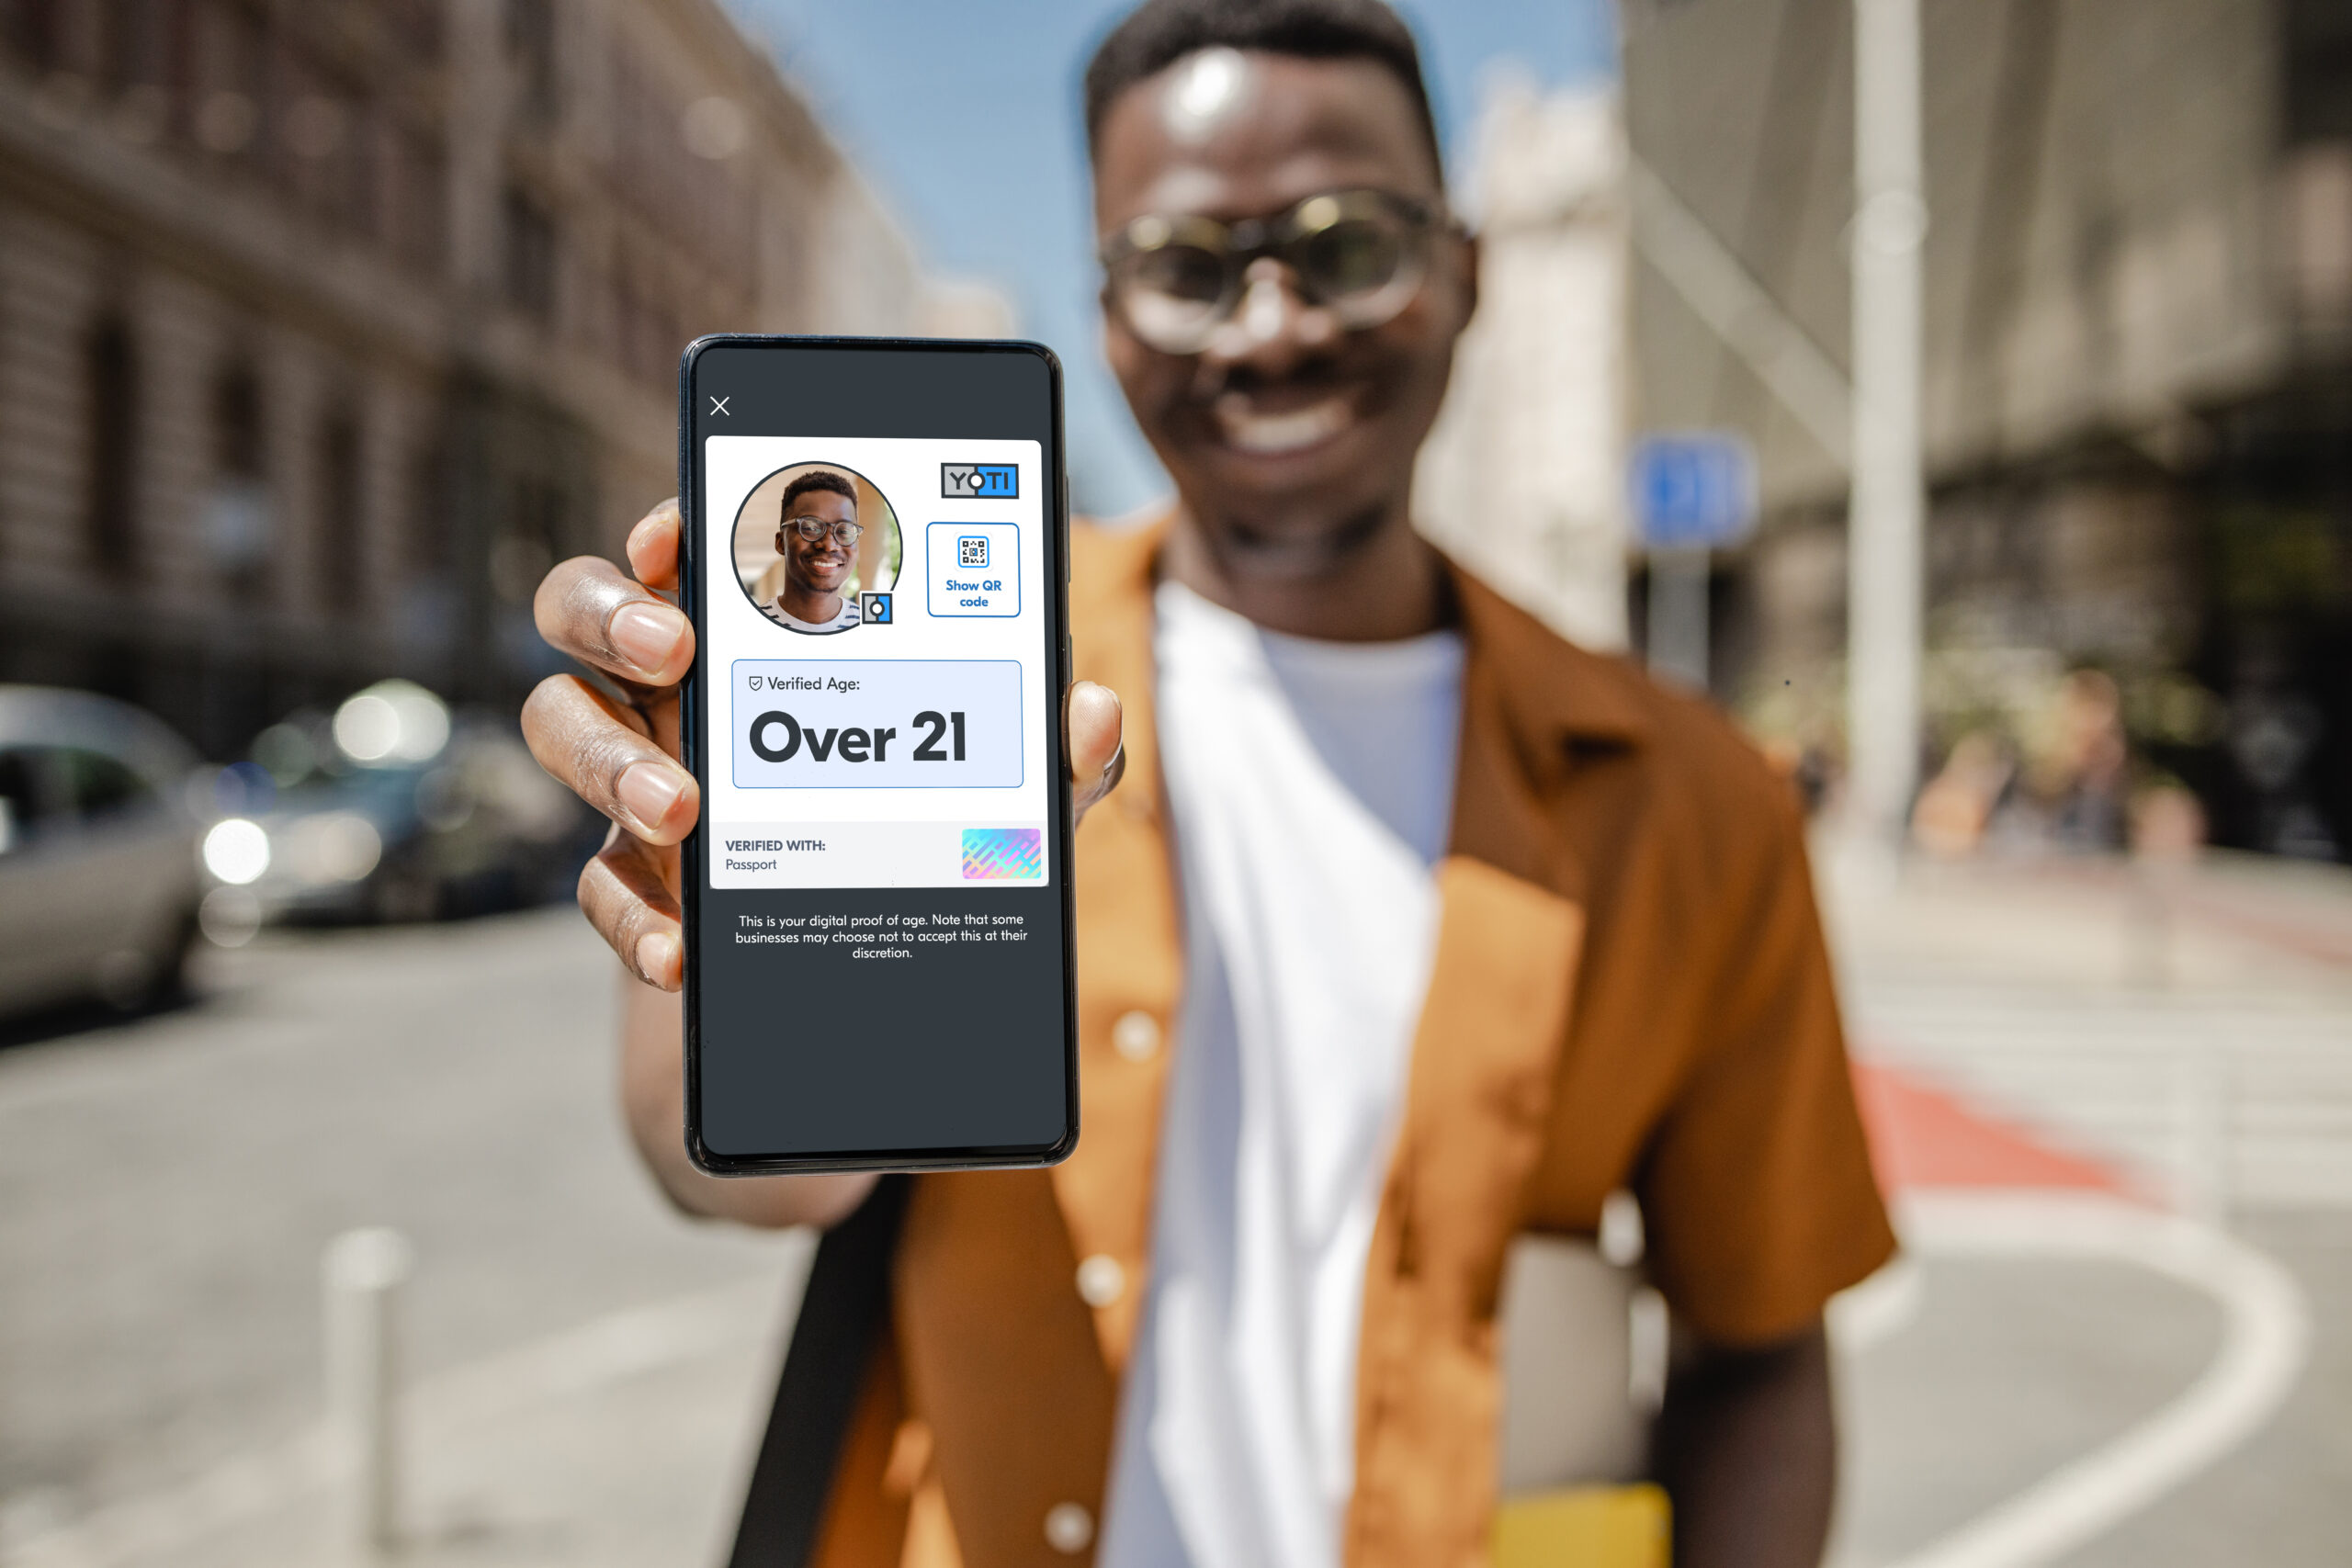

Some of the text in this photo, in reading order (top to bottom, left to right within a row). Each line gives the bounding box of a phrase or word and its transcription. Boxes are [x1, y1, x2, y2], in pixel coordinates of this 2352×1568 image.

[950, 470, 1009, 491] YOTI
[945, 579, 1002, 592] Show QR
[959, 595, 989, 607] code
[767, 676, 860, 694] Verified Age:
[750, 711, 966, 762] Over 21
[725, 840, 826, 852] VERIFIED WITH:
[726, 858, 777, 873] Passport
[739, 913, 1024, 930] This is your digital proof of age. Note that some
[735, 929, 1028, 945] businesses may choose not to accept this at their
[852, 946, 913, 959] discretion.
